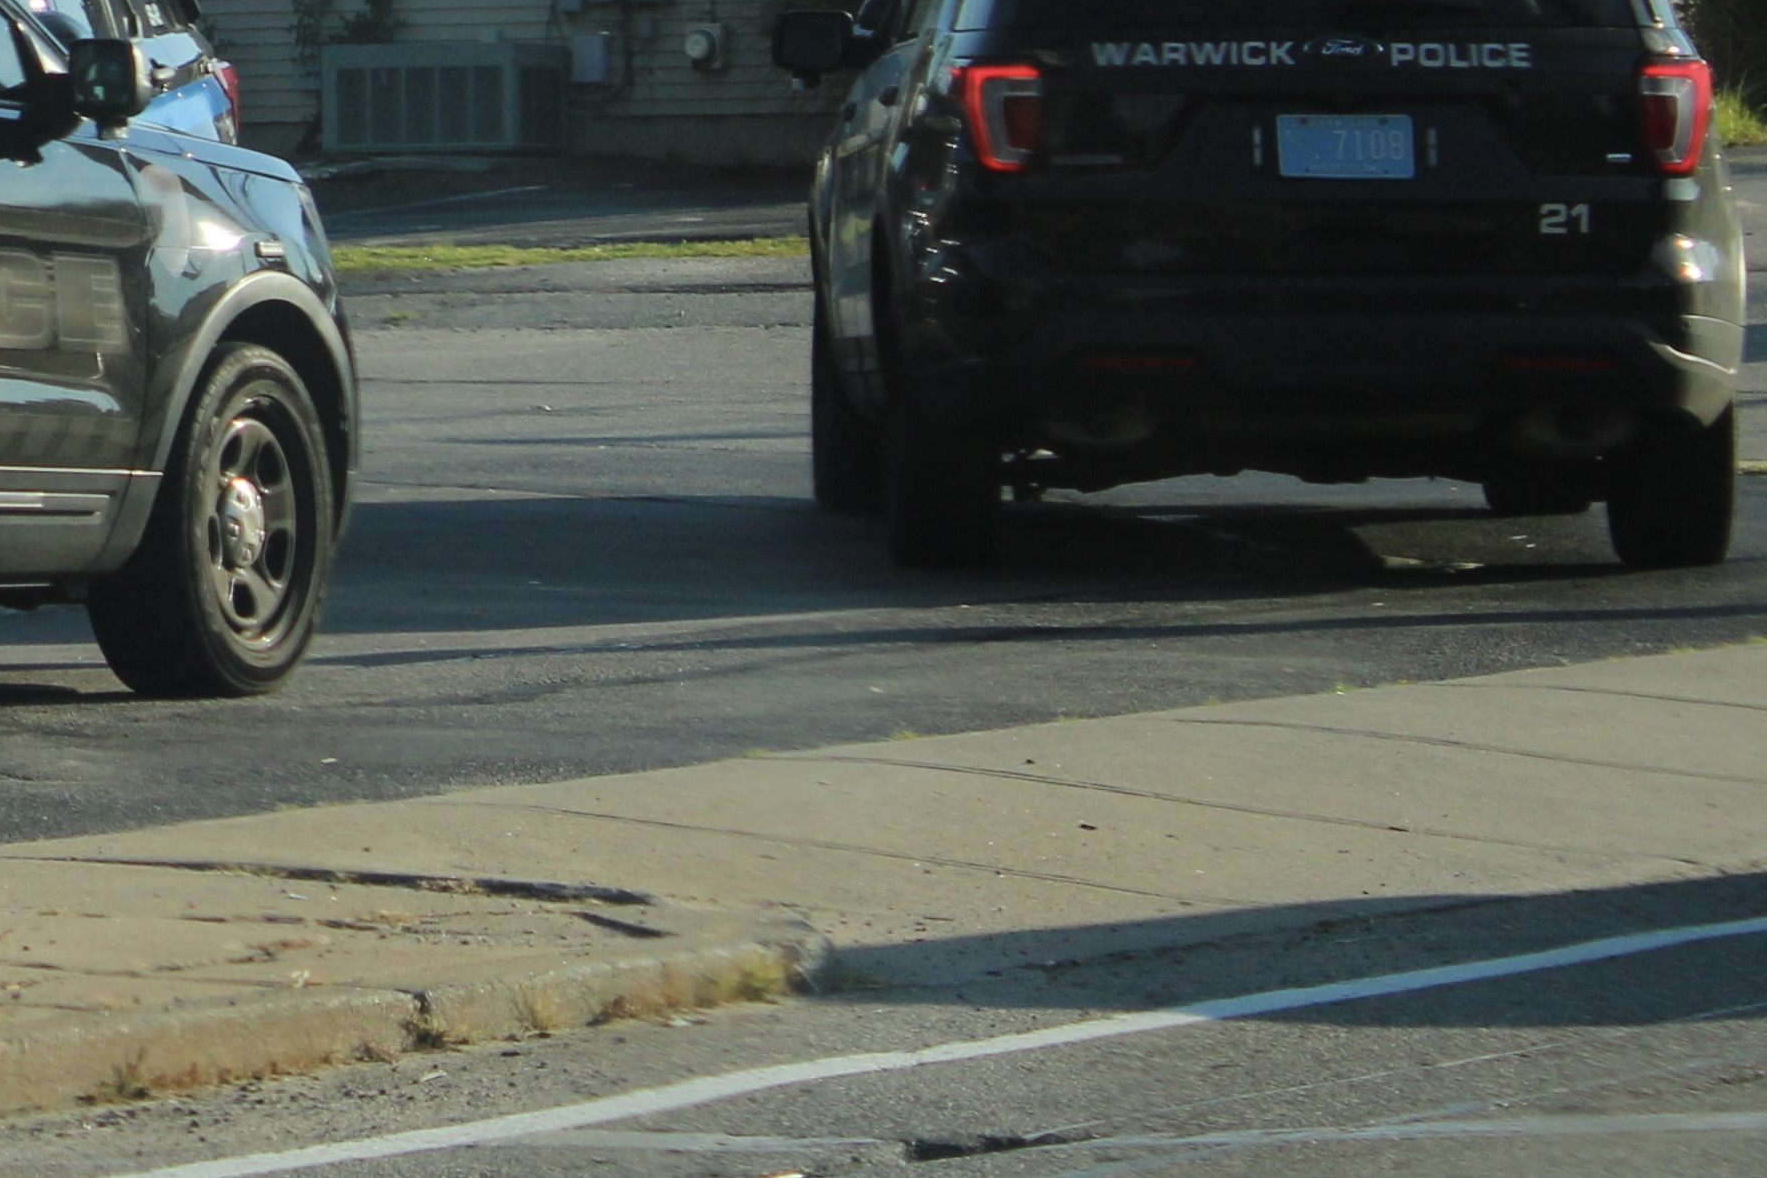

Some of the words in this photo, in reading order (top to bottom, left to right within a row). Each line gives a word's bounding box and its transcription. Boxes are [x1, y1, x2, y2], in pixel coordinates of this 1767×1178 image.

[1092, 41, 1296, 66] WARWICK
[1322, 40, 1364, 55] Ford
[1390, 41, 1532, 68] POLICE
[1332, 130, 1405, 161] 7108
[1539, 203, 1589, 234] 21
